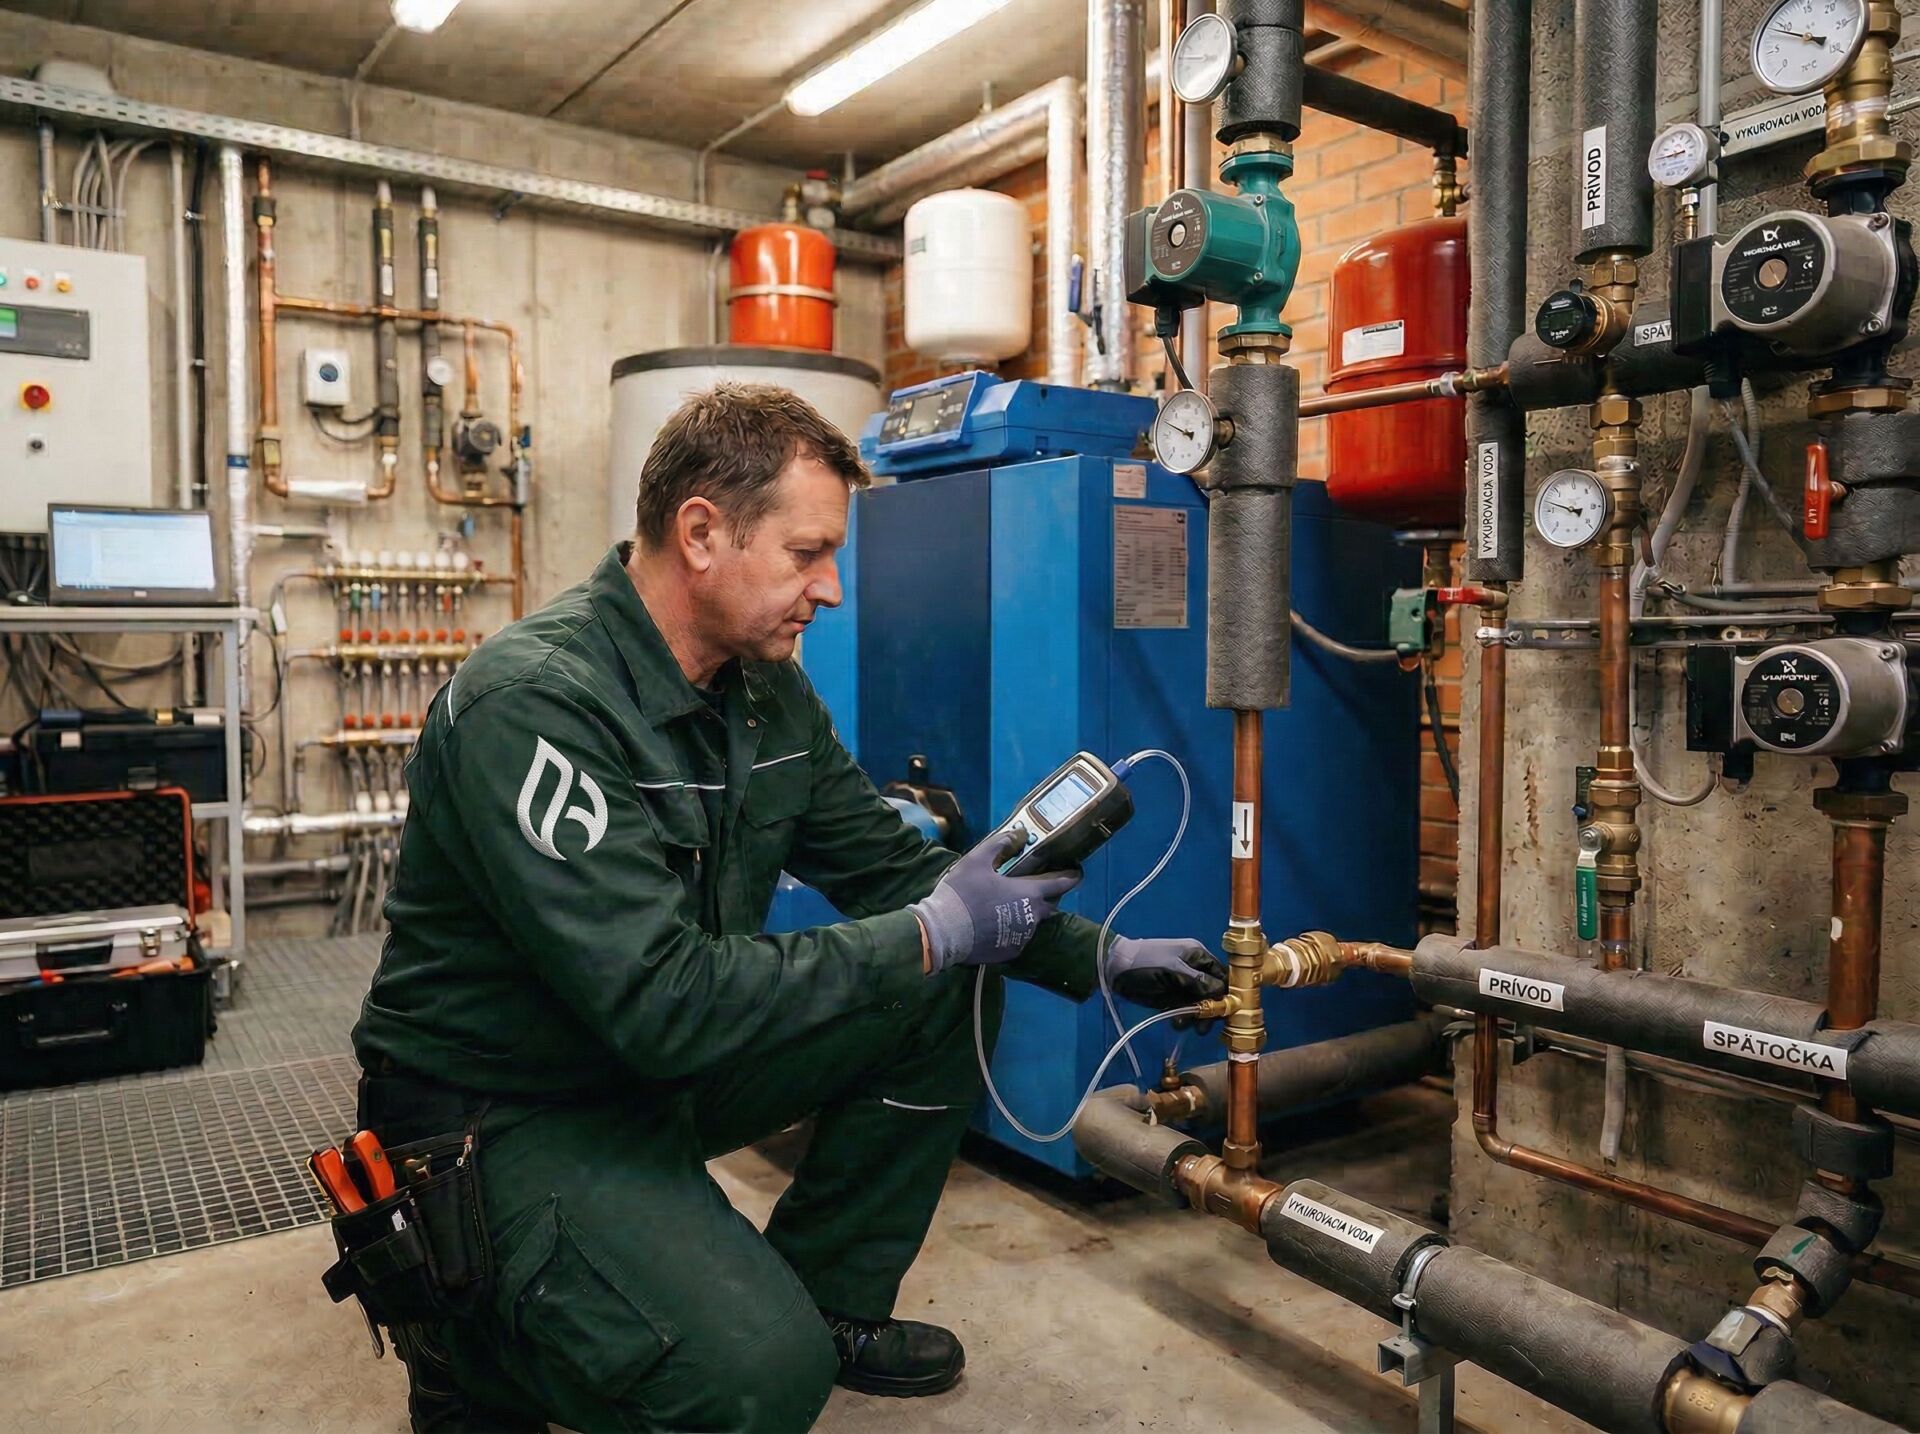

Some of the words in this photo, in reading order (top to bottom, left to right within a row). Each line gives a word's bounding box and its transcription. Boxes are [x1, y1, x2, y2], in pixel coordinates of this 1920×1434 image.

[1489, 977, 1552, 1003] PRÍVOD
[1713, 1030, 1835, 1072] SPÄTOČKA
[1347, 1224, 1374, 1245] VODA
